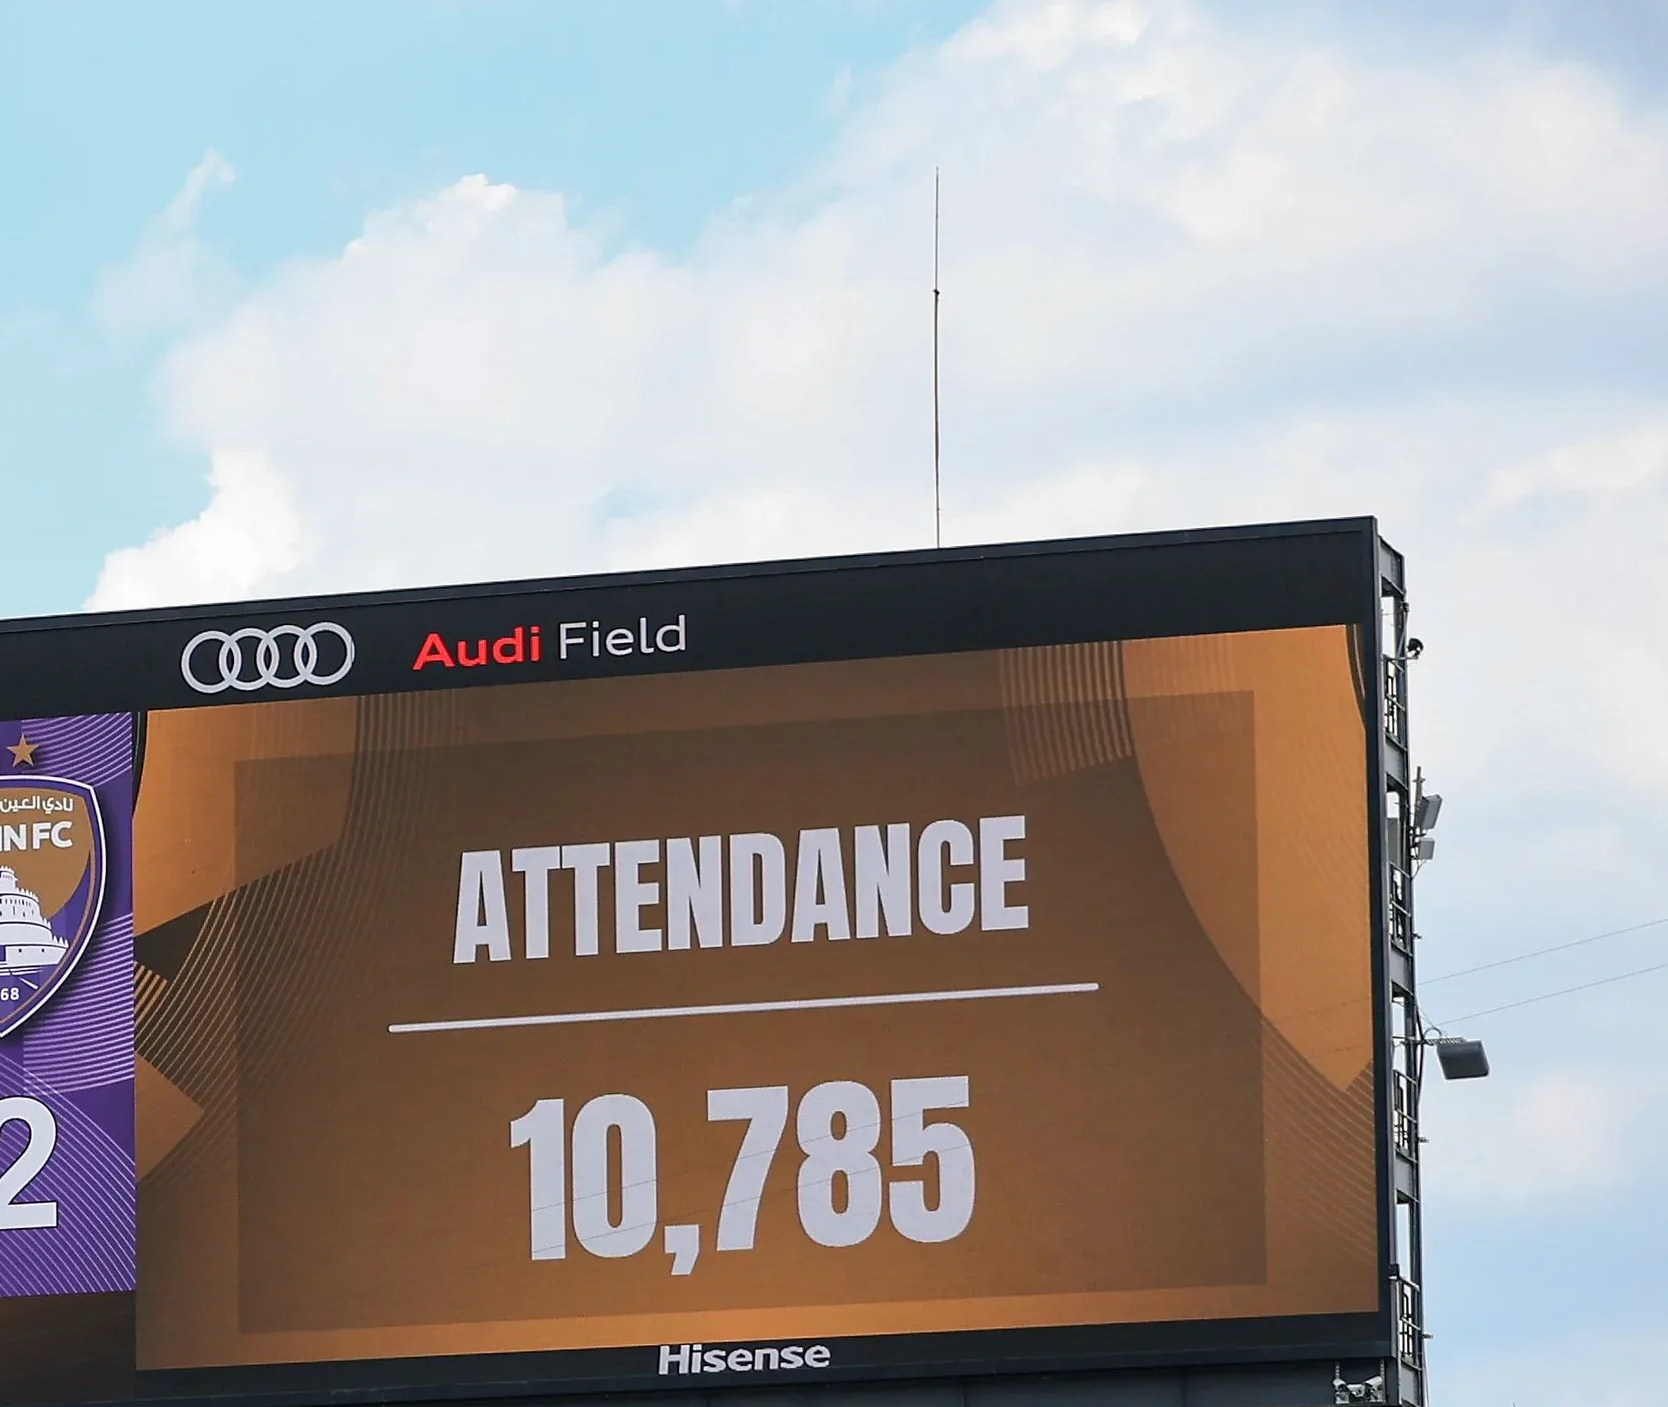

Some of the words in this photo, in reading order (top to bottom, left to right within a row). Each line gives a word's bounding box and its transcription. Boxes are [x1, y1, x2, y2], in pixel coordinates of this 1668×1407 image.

[413, 626, 540, 670] Audi
[559, 614, 686, 660] Field
[32, 820, 73, 850] FC
[453, 815, 1029, 964] ATTENDANCE
[510, 1075, 976, 1276] 10,785
[658, 1343, 831, 1375] Hisense
